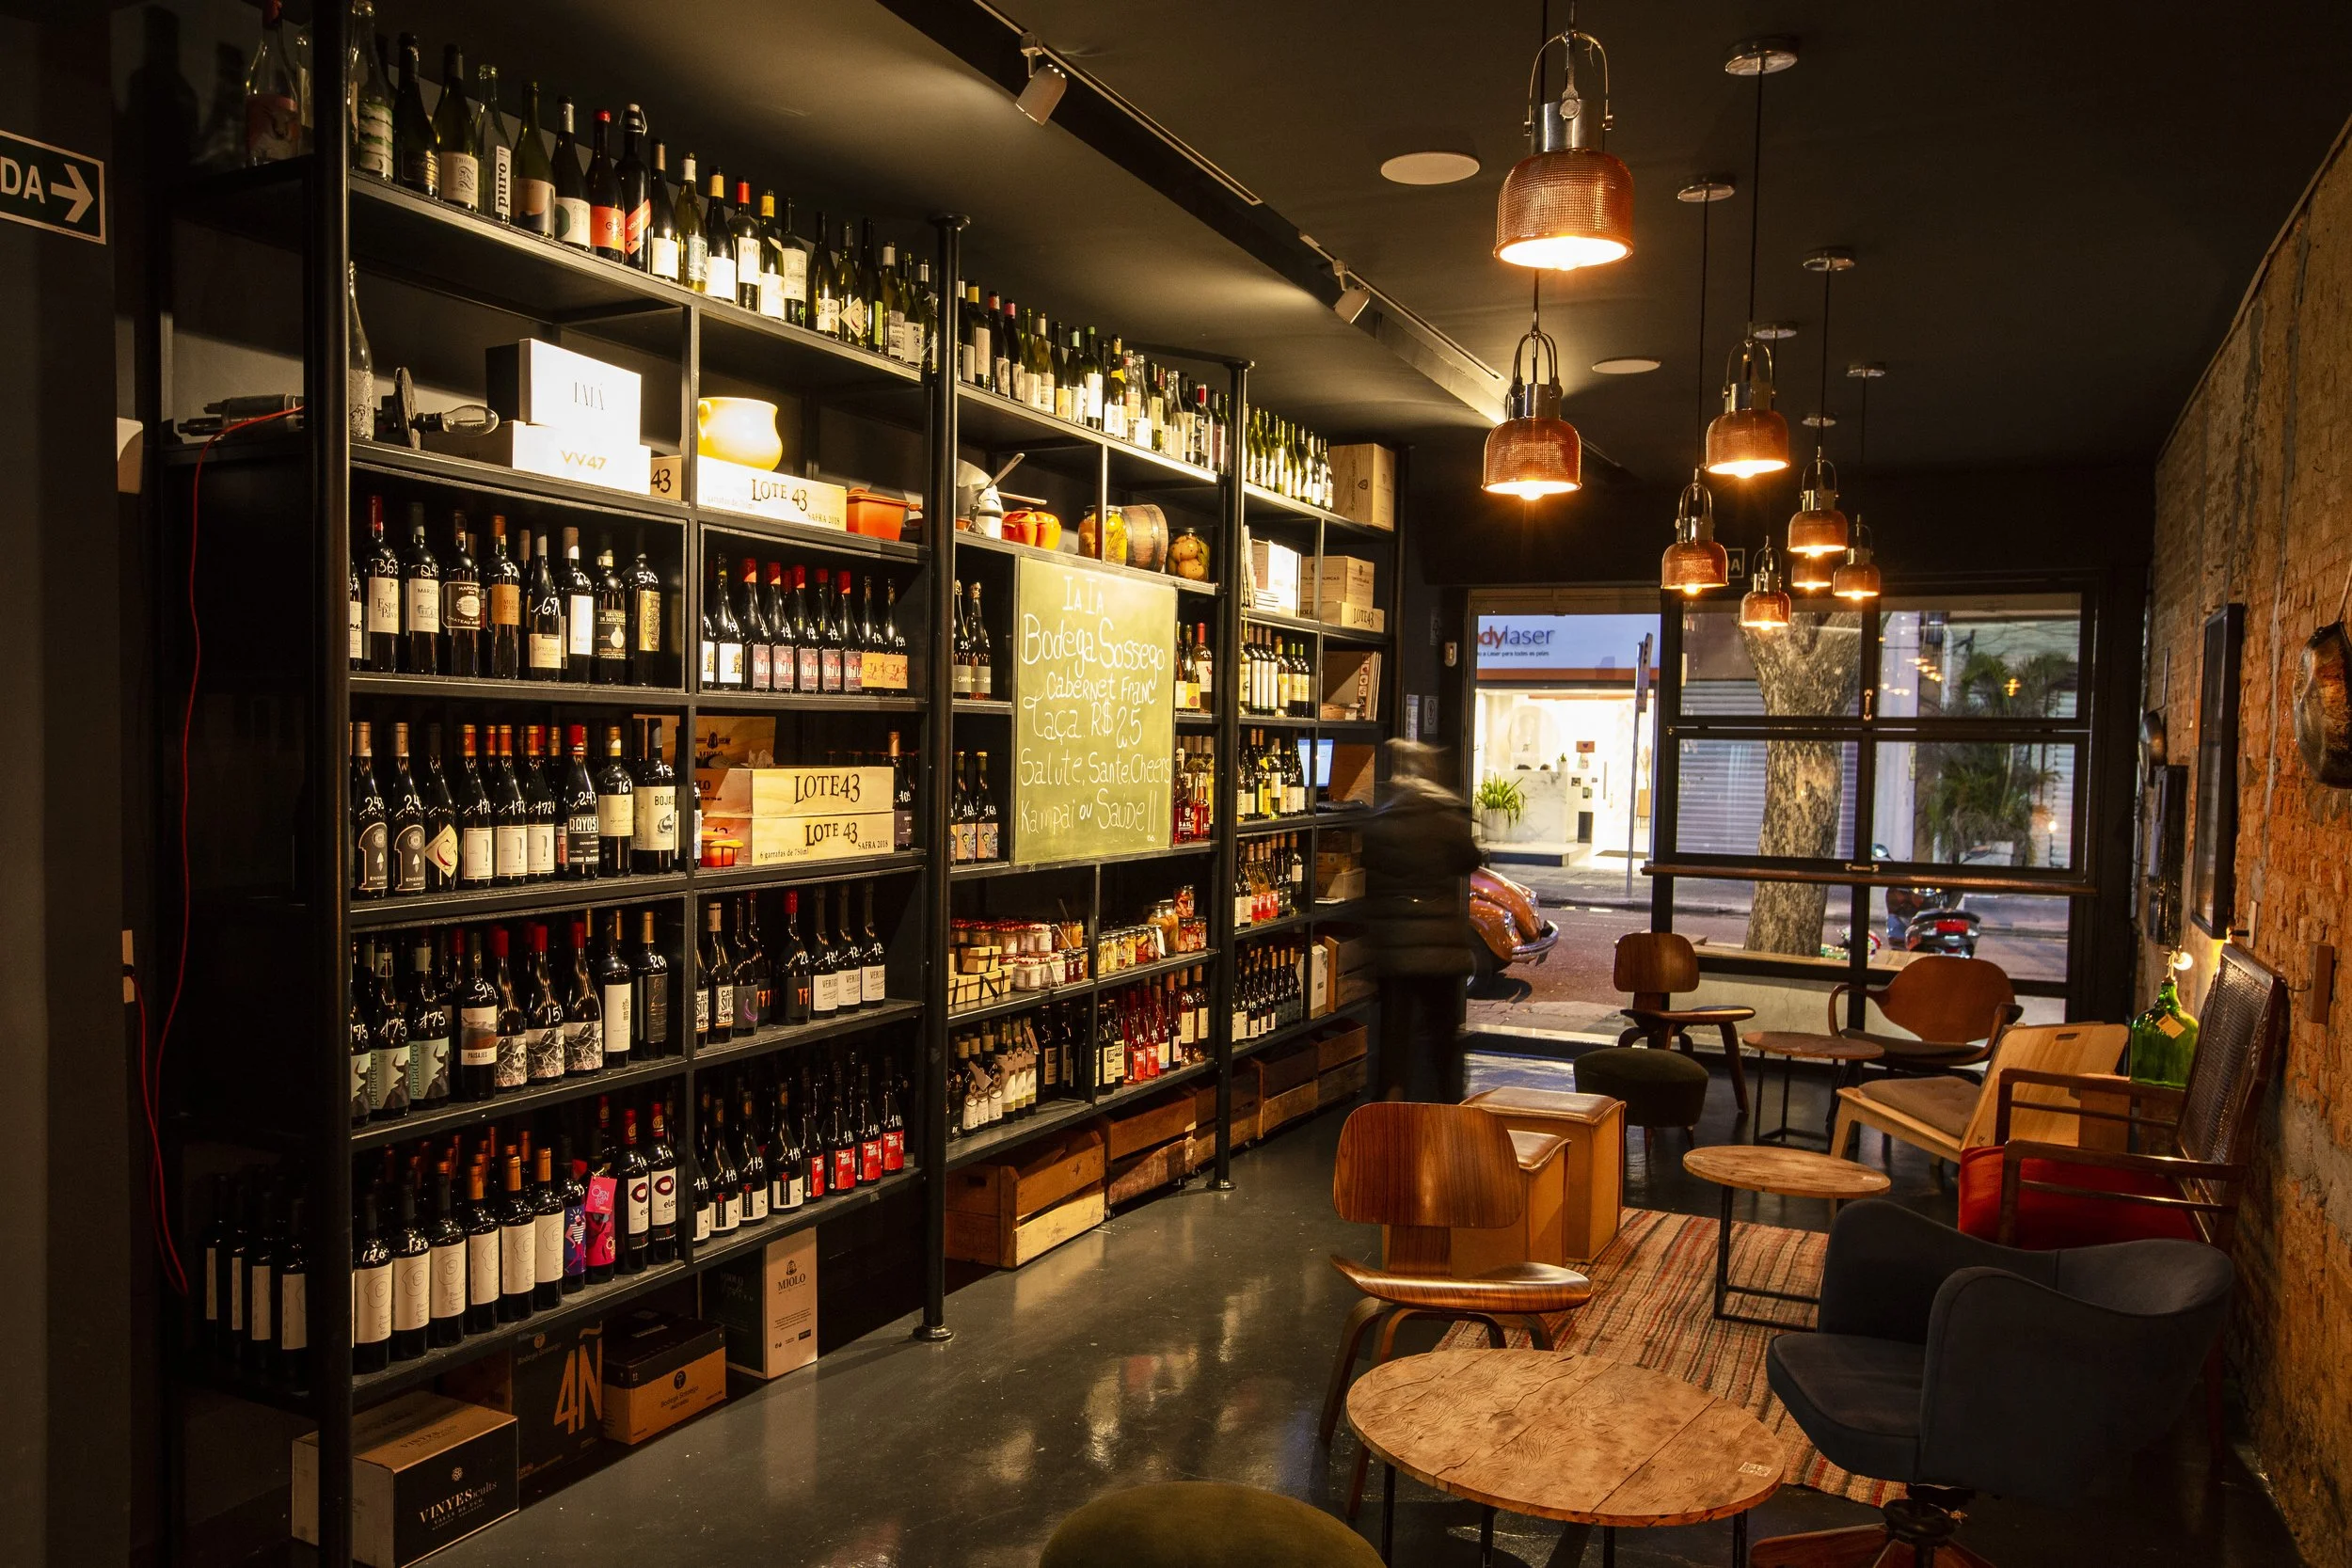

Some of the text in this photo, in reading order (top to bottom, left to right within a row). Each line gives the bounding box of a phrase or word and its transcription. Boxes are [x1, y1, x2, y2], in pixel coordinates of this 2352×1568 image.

[0, 155, 46, 204] DA
[498, 162, 509, 211] puro
[651, 468, 672, 494] 43
[752, 479, 807, 512] LOTE 43
[1020, 613, 1166, 681] Bodega Sossego
[1090, 698, 1114, 736] R$
[1116, 705, 1142, 749] 25
[804, 821, 858, 847] LOTE 43
[1021, 800, 1075, 835] Kampai
[764, 850, 786, 861] garrafas
[787, 848, 793, 857] de
[857, 842, 876, 850] SAFRA
[411, 1044, 422, 1098] ganadero
[777, 1273, 806, 1291] MIOLO
